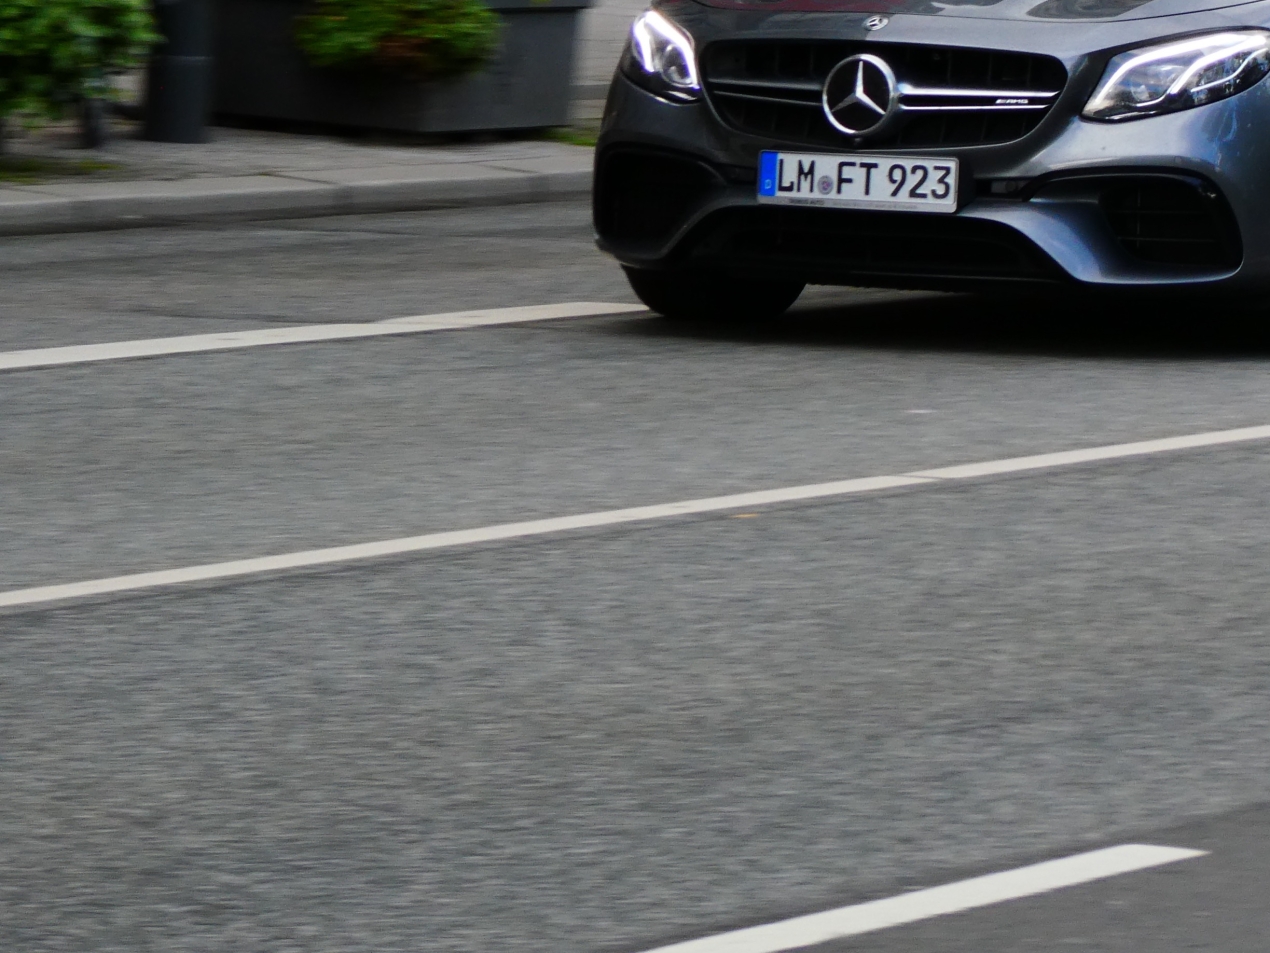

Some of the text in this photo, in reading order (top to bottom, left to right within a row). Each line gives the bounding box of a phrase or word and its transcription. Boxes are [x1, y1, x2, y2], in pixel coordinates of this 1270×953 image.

[778, 158, 951, 200] LM FT 923
